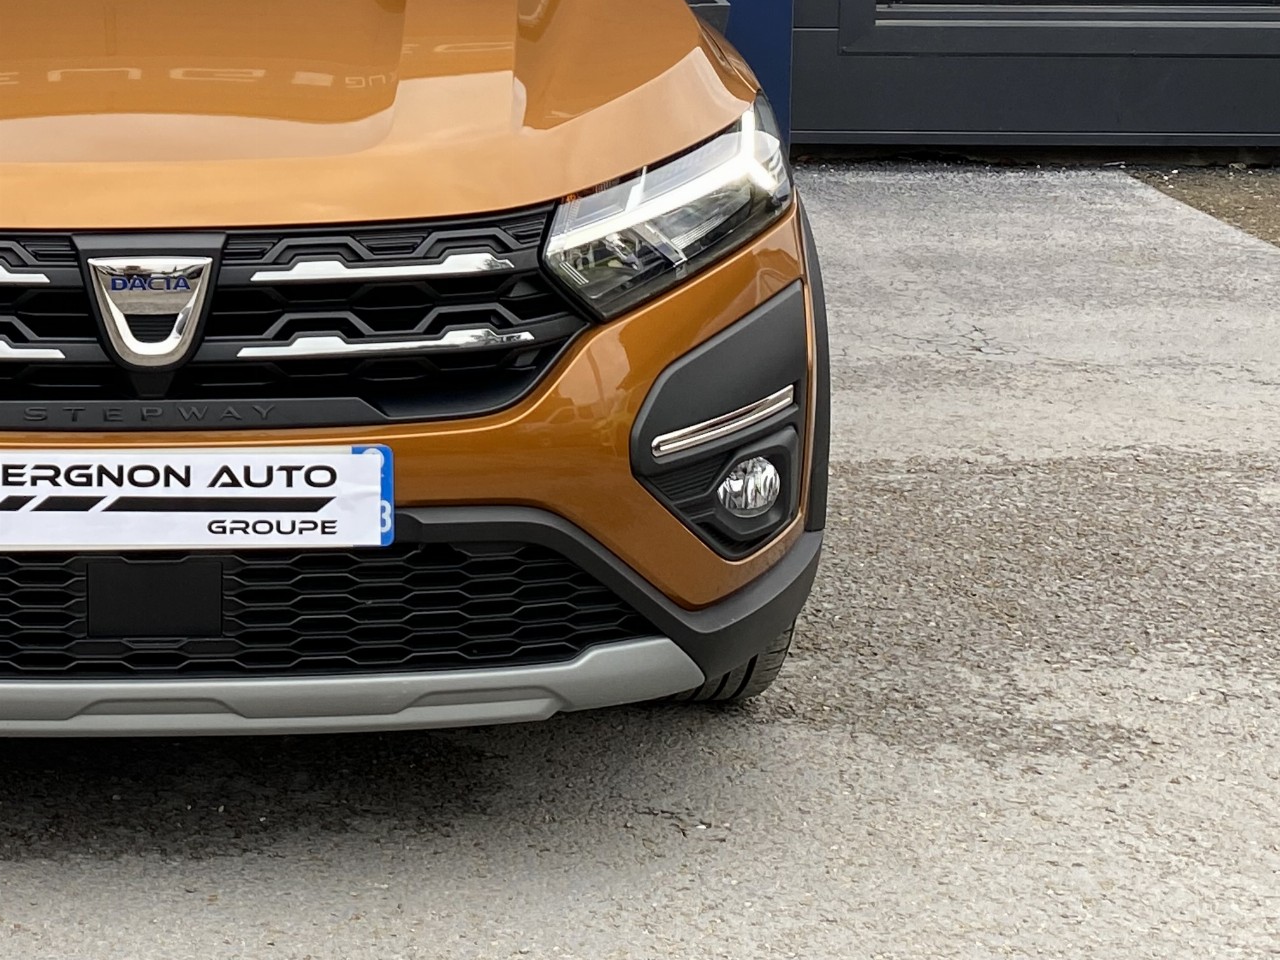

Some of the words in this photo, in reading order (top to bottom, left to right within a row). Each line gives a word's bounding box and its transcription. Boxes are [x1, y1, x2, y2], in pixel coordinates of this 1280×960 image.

[110, 275, 191, 291] DACIA
[22, 404, 277, 423] STEPWAY
[206, 464, 338, 489] AUTO
[206, 519, 338, 536] GROUPE
